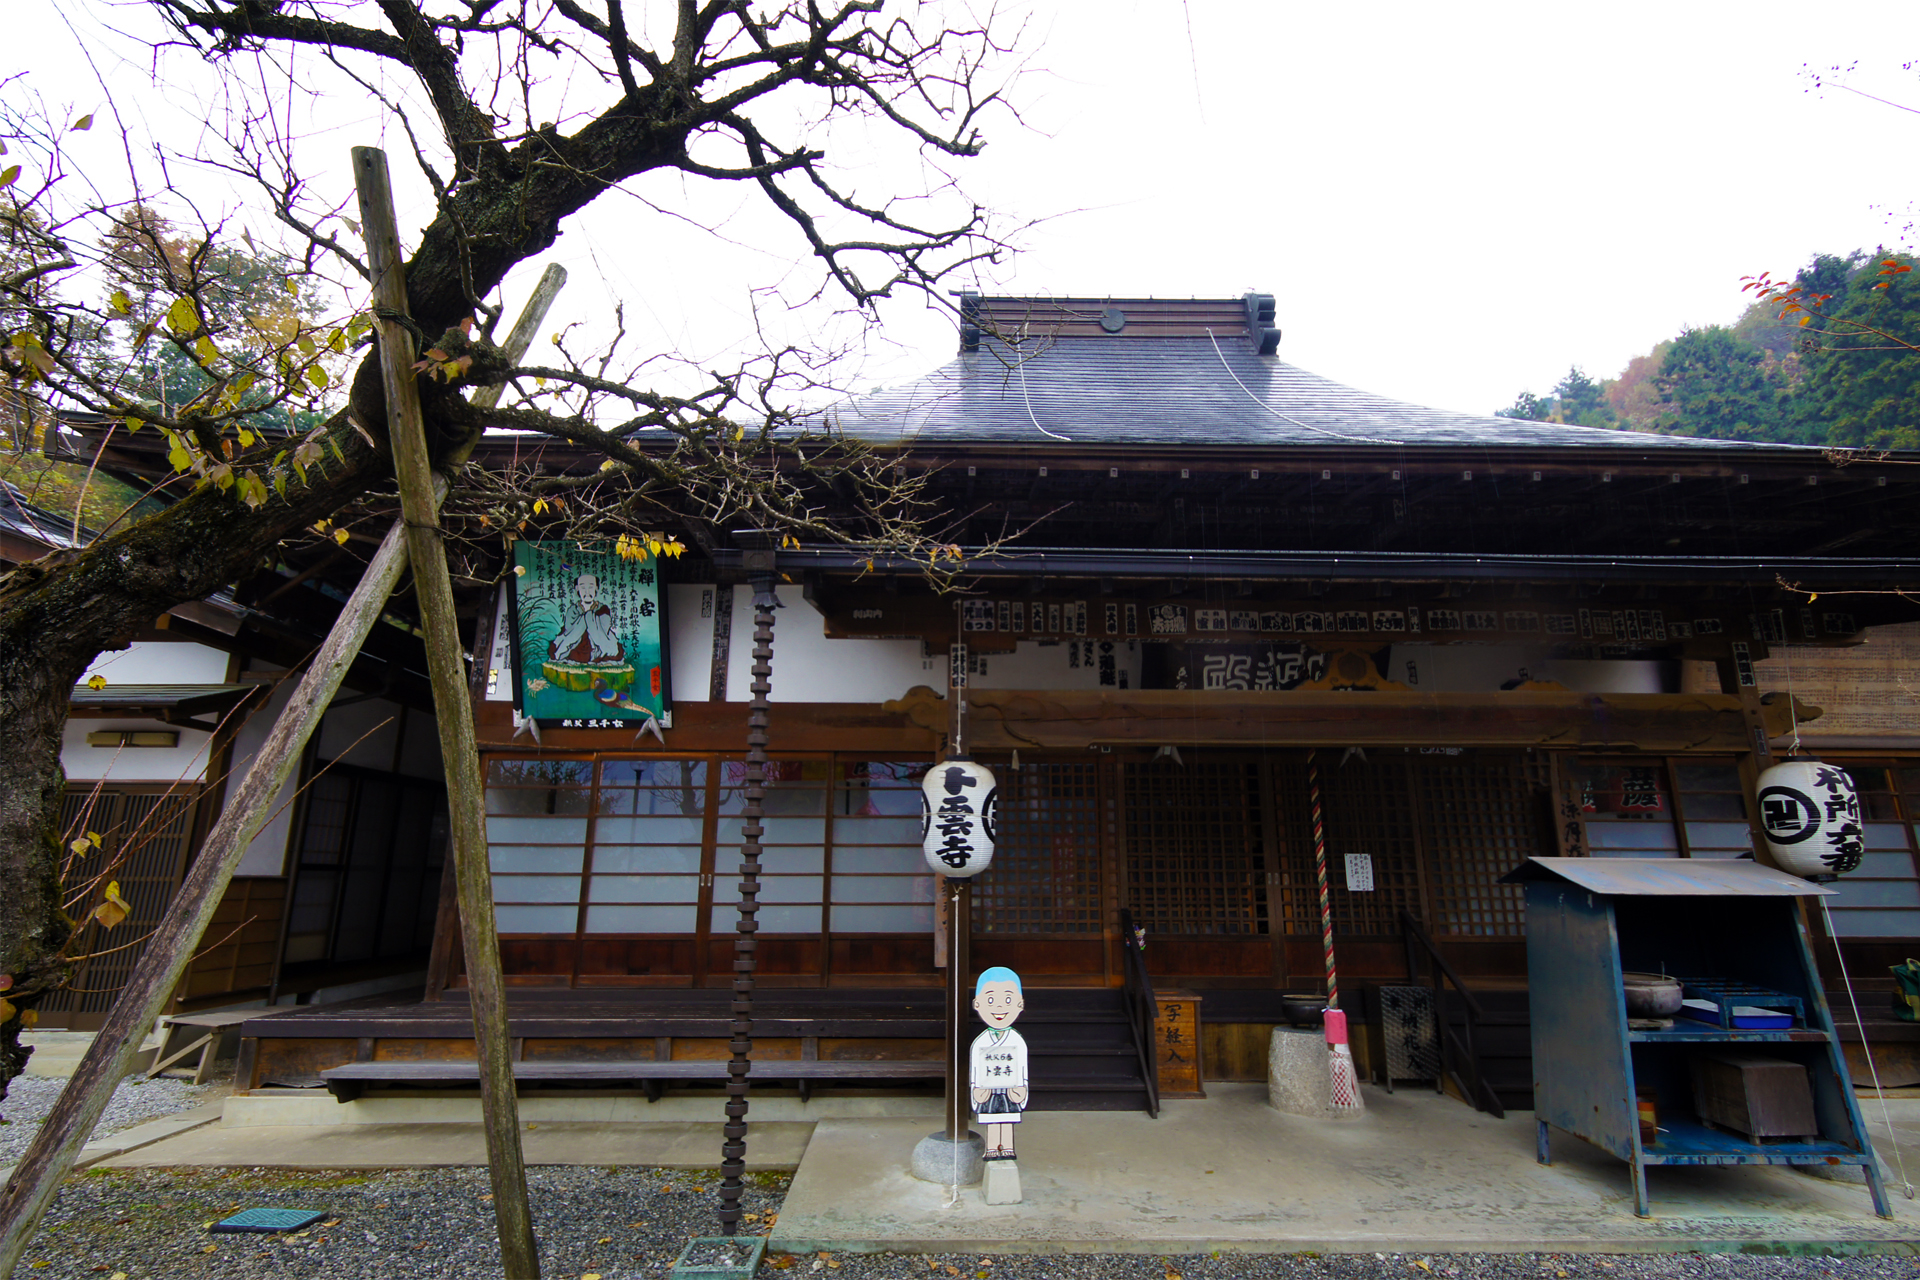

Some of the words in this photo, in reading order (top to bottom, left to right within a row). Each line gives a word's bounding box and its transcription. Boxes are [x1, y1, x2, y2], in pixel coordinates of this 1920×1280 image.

[1813, 767, 1864, 872] 札所六番
[1164, 1003, 1186, 1063] 写経入
